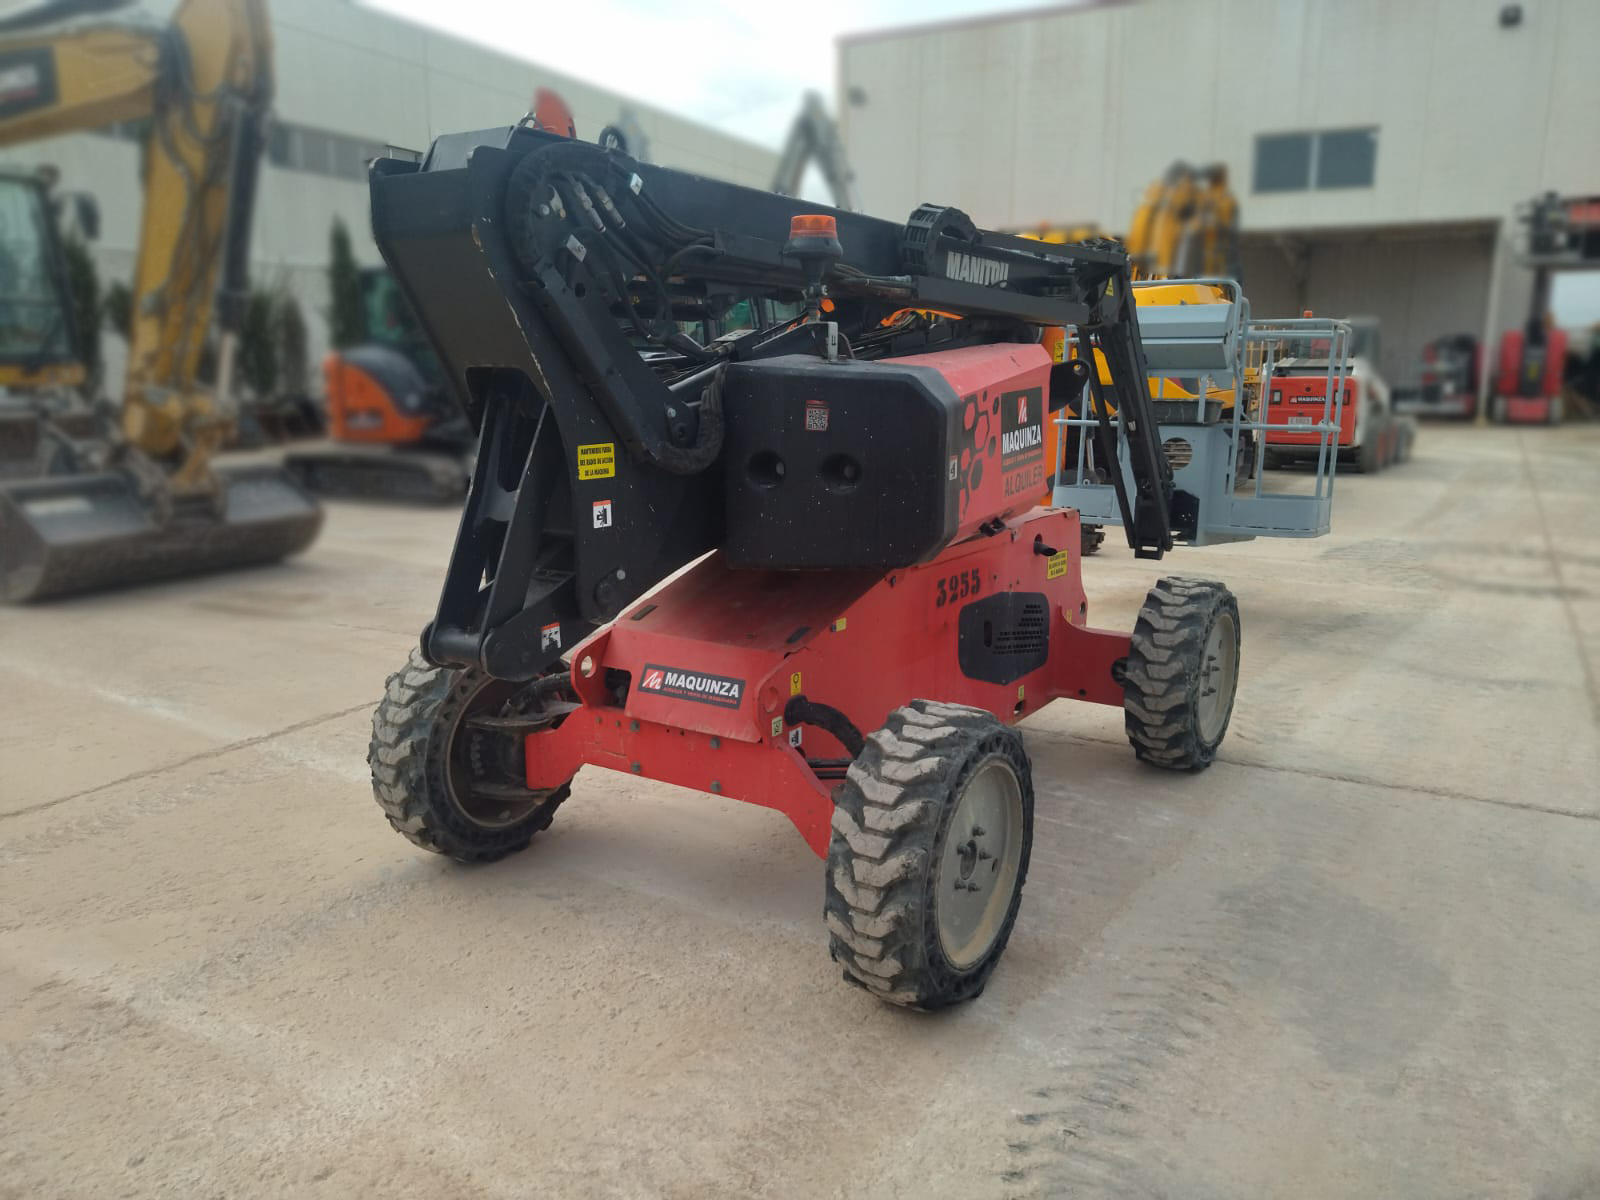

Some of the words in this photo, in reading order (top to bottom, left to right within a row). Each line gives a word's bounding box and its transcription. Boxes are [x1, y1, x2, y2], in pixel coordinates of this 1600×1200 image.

[1002, 424, 1042, 455] MAQUINZA
[1004, 463, 1043, 497] ALQUILER
[936, 568, 981, 608] 3255
[664, 672, 739, 698] MAQUINZA
